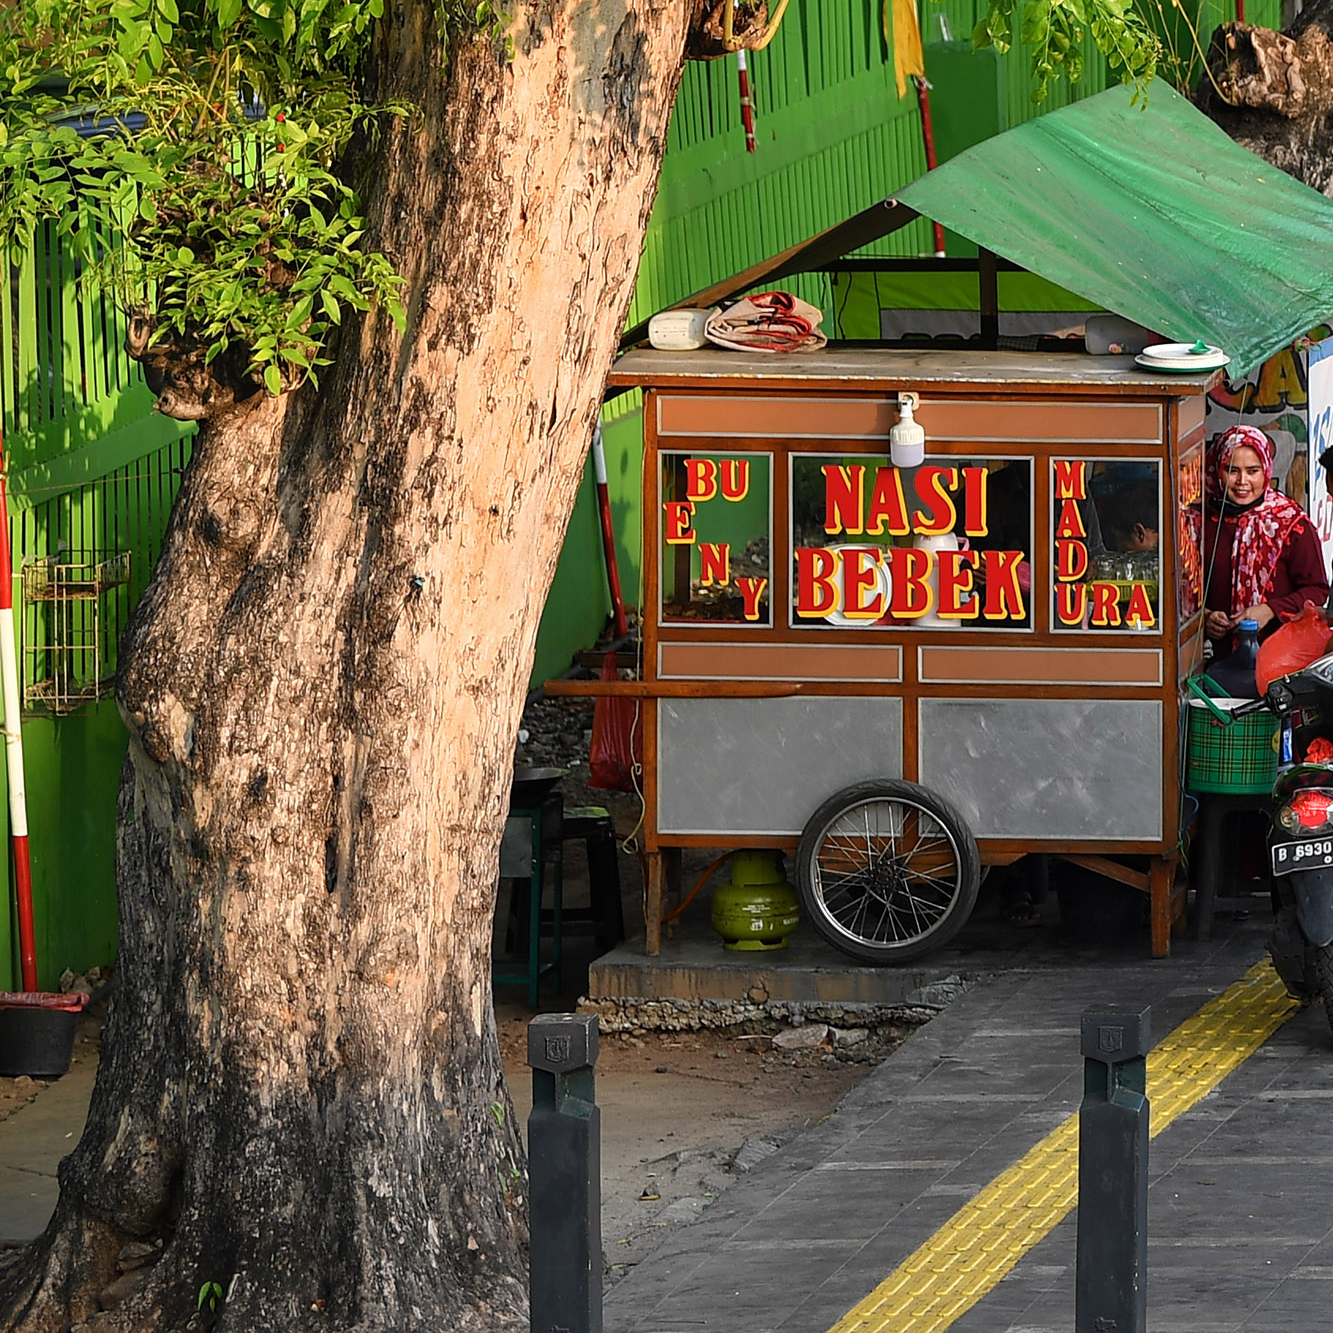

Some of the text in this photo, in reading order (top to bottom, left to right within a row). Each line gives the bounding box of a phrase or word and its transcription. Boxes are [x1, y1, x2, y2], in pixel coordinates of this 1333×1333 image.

[684, 459, 750, 502] BU
[820, 465, 989, 537] NASI
[794, 547, 1026, 620] BEBEK
[1278, 848, 1288, 862] B
[1295, 841, 1332, 858] 6930
